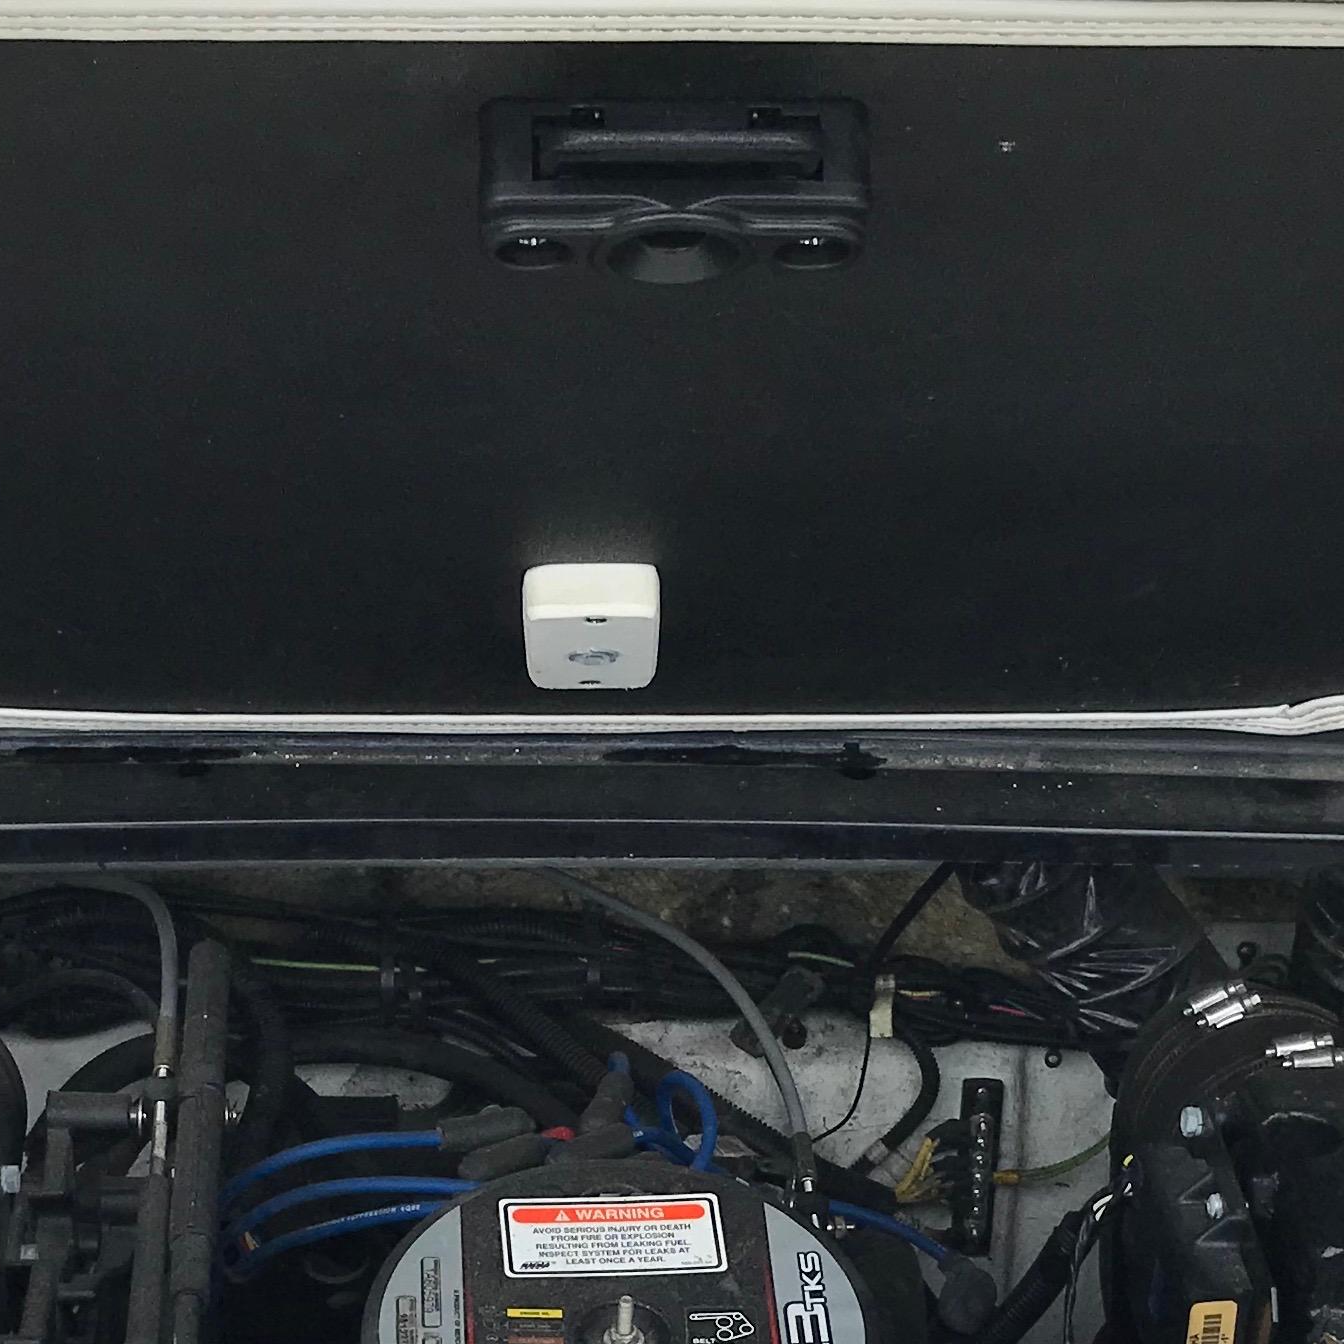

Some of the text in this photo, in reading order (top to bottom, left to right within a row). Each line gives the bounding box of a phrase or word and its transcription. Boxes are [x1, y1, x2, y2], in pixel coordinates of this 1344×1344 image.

[575, 1207, 665, 1221] WARNING
[533, 1223, 692, 1235] AVOID SERIOUS INJURY OR DEATH
[550, 1234, 578, 1242] FROM
[605, 1233, 619, 1241] OR
[621, 1231, 675, 1240] EXPLOSION
[535, 1242, 588, 1250] RESULTING
[591, 1241, 618, 1249] FROM
[621, 1240, 662, 1248] LEAKING
[539, 1246, 690, 1259] INSPECT SYSTEM FOR LEAKS AT
[565, 1257, 596, 1265] LEAST
[599, 1256, 626, 1264] ONCE
